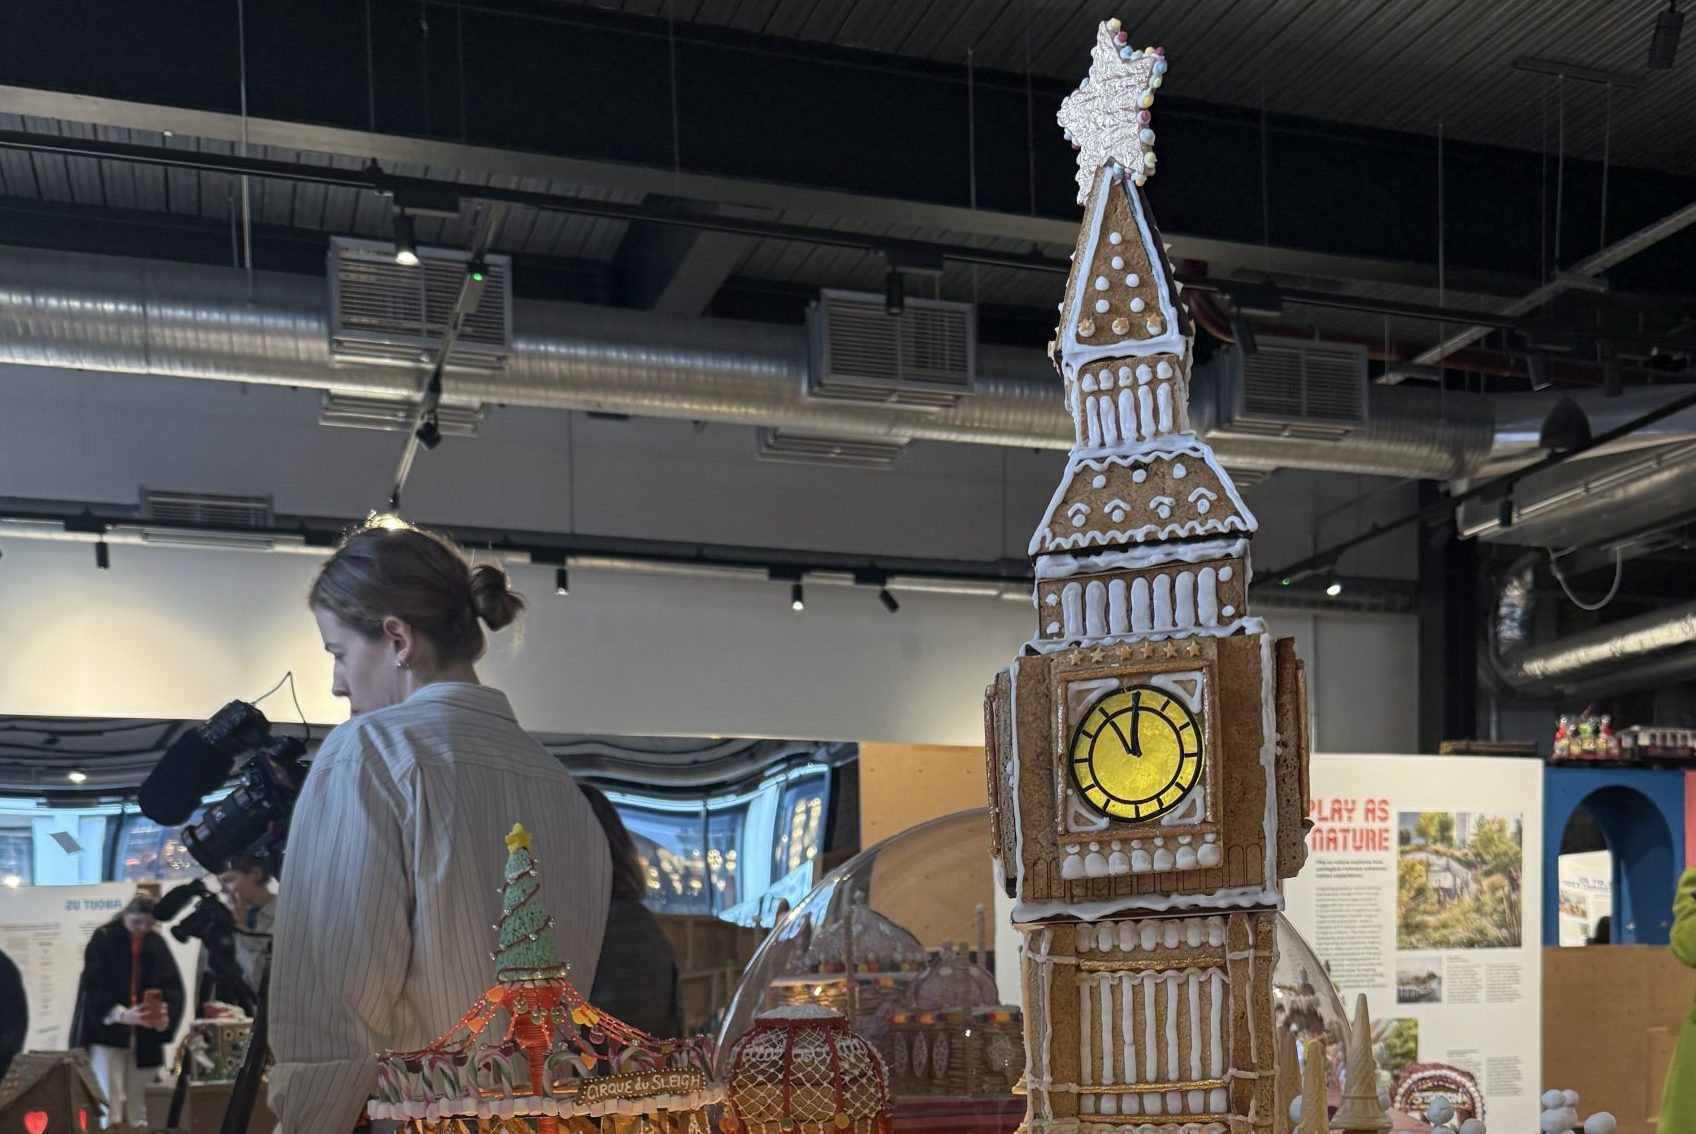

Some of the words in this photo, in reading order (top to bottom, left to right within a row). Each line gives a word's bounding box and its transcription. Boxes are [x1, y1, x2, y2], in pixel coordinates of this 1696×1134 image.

[1364, 799, 1390, 822] AS
[1311, 828, 1390, 852] NATURE
[586, 1080, 633, 1100] CIRQUE
[635, 1077, 649, 1090] du
[651, 1074, 701, 1090] SLEIGH
